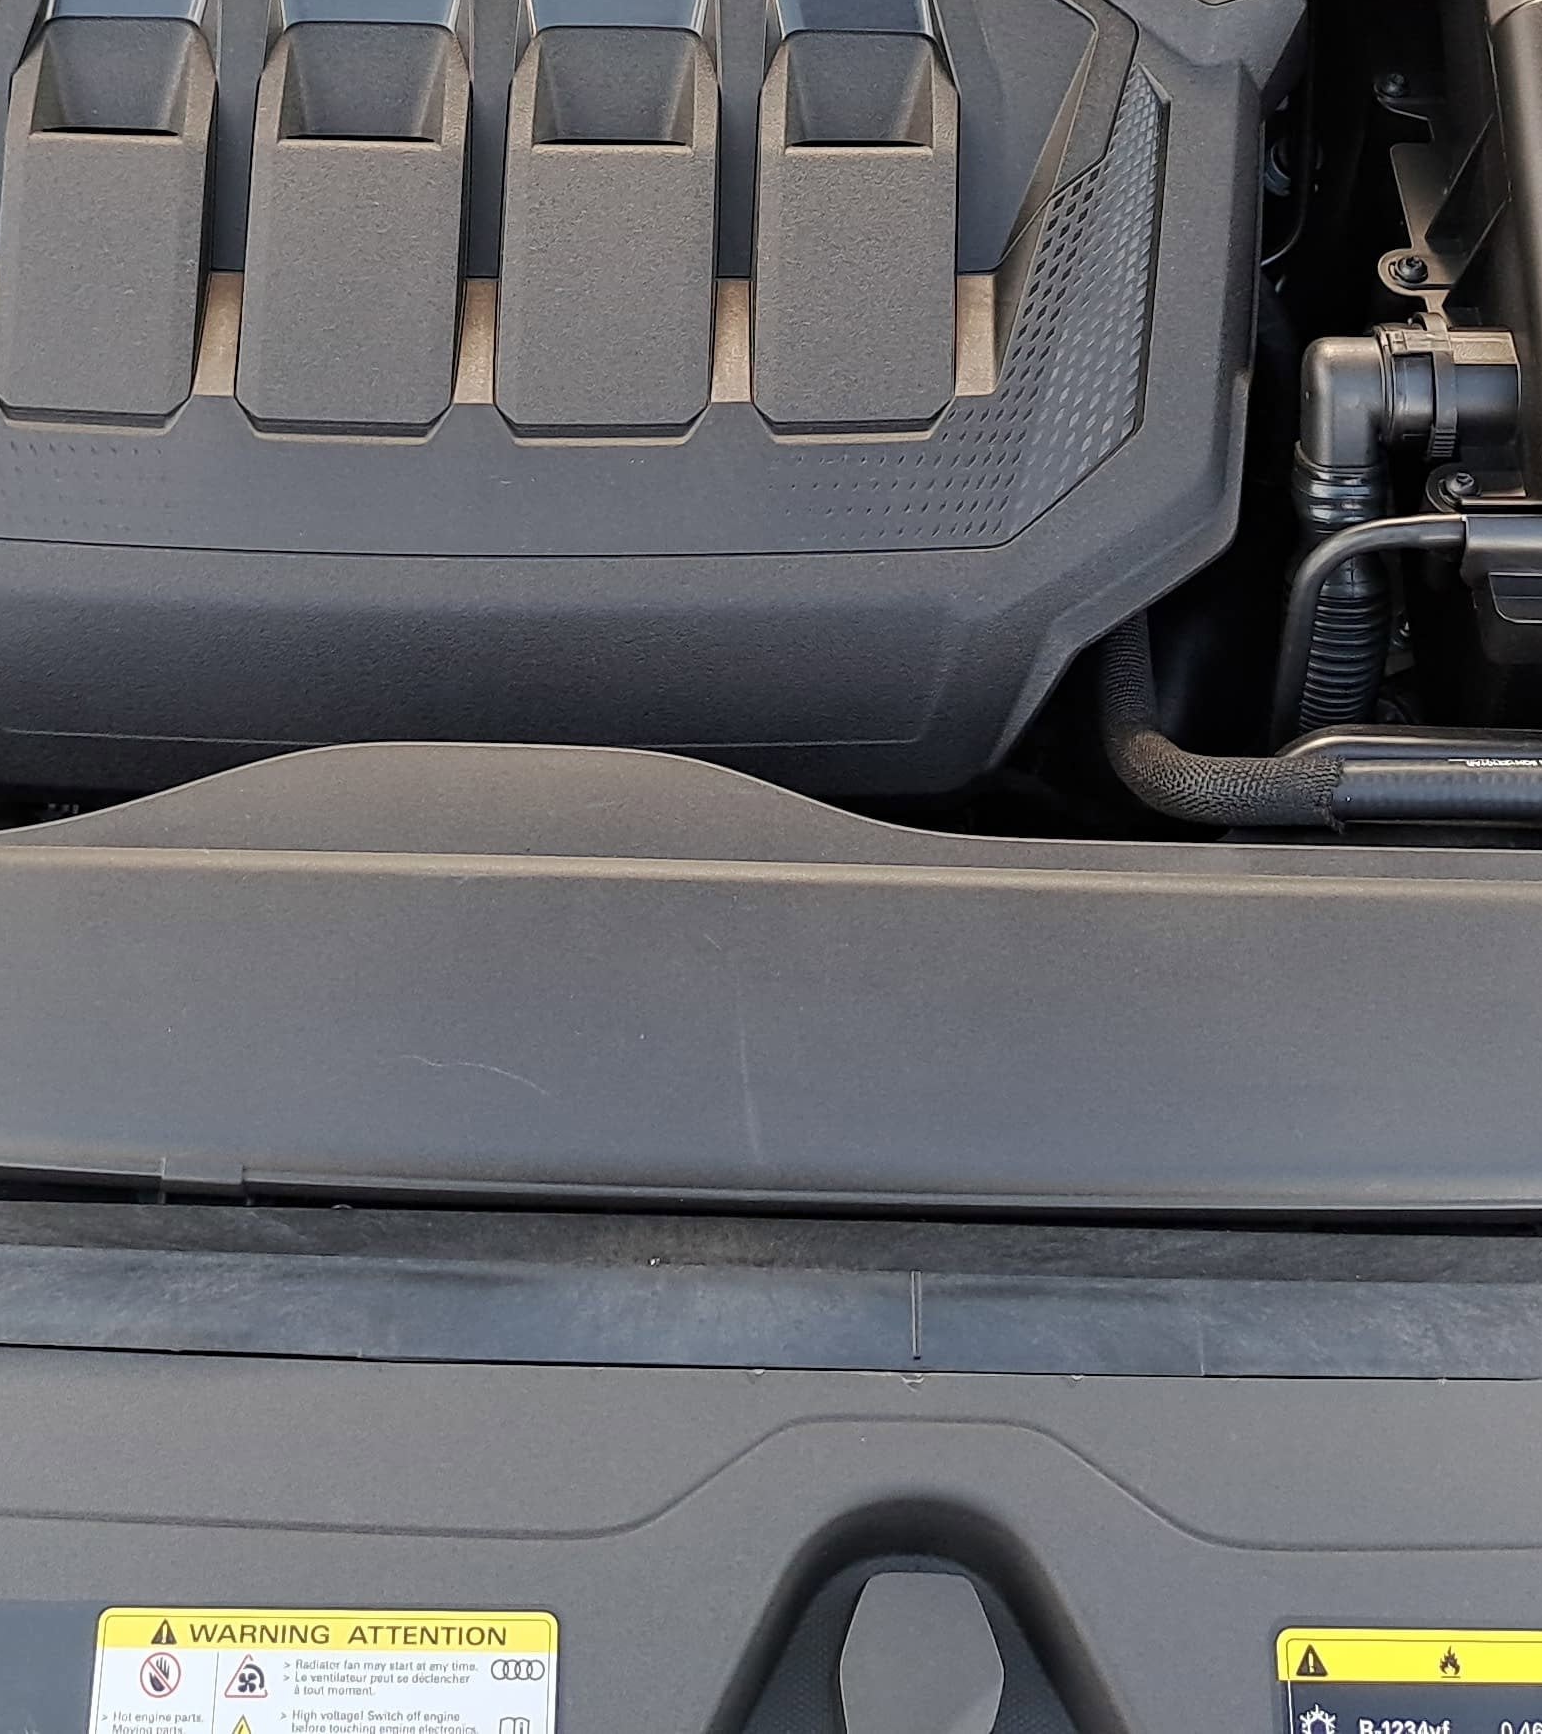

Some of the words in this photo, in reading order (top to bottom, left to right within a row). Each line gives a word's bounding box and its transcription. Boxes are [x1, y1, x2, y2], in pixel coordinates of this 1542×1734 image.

[189, 1623, 330, 1644] WARNING
[347, 1624, 507, 1646] ATTENTION
[295, 1659, 340, 1670] Radiator
[344, 1660, 359, 1670] fan
[364, 1661, 386, 1672] may
[389, 1661, 413, 1671] start
[416, 1661, 426, 1671] at
[429, 1662, 447, 1673] any
[451, 1661, 479, 1671] time.
[295, 1672, 307, 1682] Le
[310, 1673, 367, 1683] ventilateur
[370, 1674, 394, 1684] peut
[397, 1675, 409, 1683] se
[412, 1674, 470, 1684] déclencher
[303, 1686, 325, 1695] tout
[114, 1711, 132, 1721] Hot
[135, 1712, 172, 1723] engine
[175, 1713, 204, 1723] parts.
[292, 1710, 317, 1722] High
[320, 1710, 364, 1722] voltage!
[368, 1711, 403, 1721] Switch
[407, 1711, 421, 1721] off
[424, 1713, 460, 1724] engine
[112, 1724, 153, 1734] Moving
[291, 1723, 326, 1734] before
[329, 1724, 376, 1734] touching
[379, 1725, 416, 1734] engine
